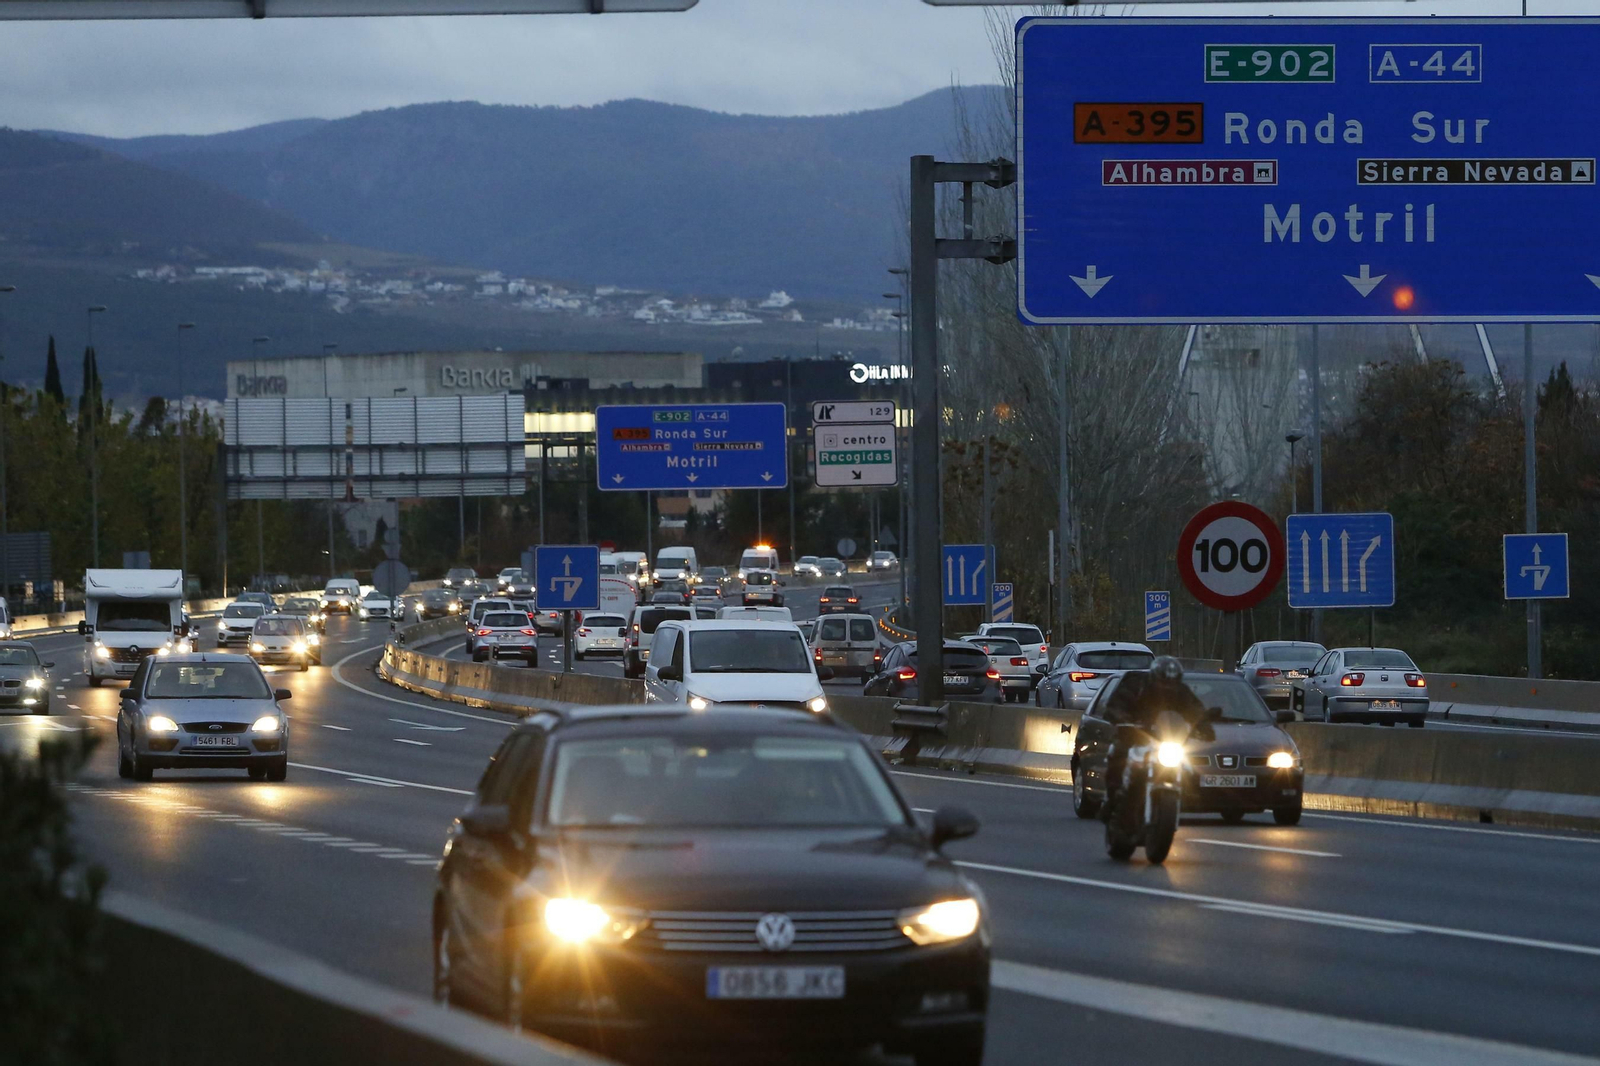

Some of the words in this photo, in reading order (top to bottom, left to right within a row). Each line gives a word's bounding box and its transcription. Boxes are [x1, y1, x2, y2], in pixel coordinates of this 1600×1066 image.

[1209, 50, 1330, 78] E-902
[1376, 50, 1476, 77] A-44
[1082, 110, 1196, 136] A-395
[1225, 112, 1364, 145] Ronda
[1411, 111, 1490, 144] Sur
[1109, 163, 1245, 184] Alhambra
[1364, 161, 1449, 182] Sierra
[1464, 161, 1562, 182] Nevada
[1264, 203, 1436, 243] Motril
[442, 364, 514, 389] Bankia
[654, 411, 691, 422] E-902
[697, 410, 727, 421] A-44
[870, 407, 890, 416] 129
[655, 429, 696, 439] Ronda
[704, 428, 728, 439] Sur
[843, 434, 886, 445] centro
[666, 455, 717, 468] Motril
[821, 452, 890, 464] Recogidas
[1195, 537, 1268, 574] 100
[994, 584, 1010, 592] 200
[1149, 594, 1167, 602] 300
[198, 736, 217, 745] 5461
